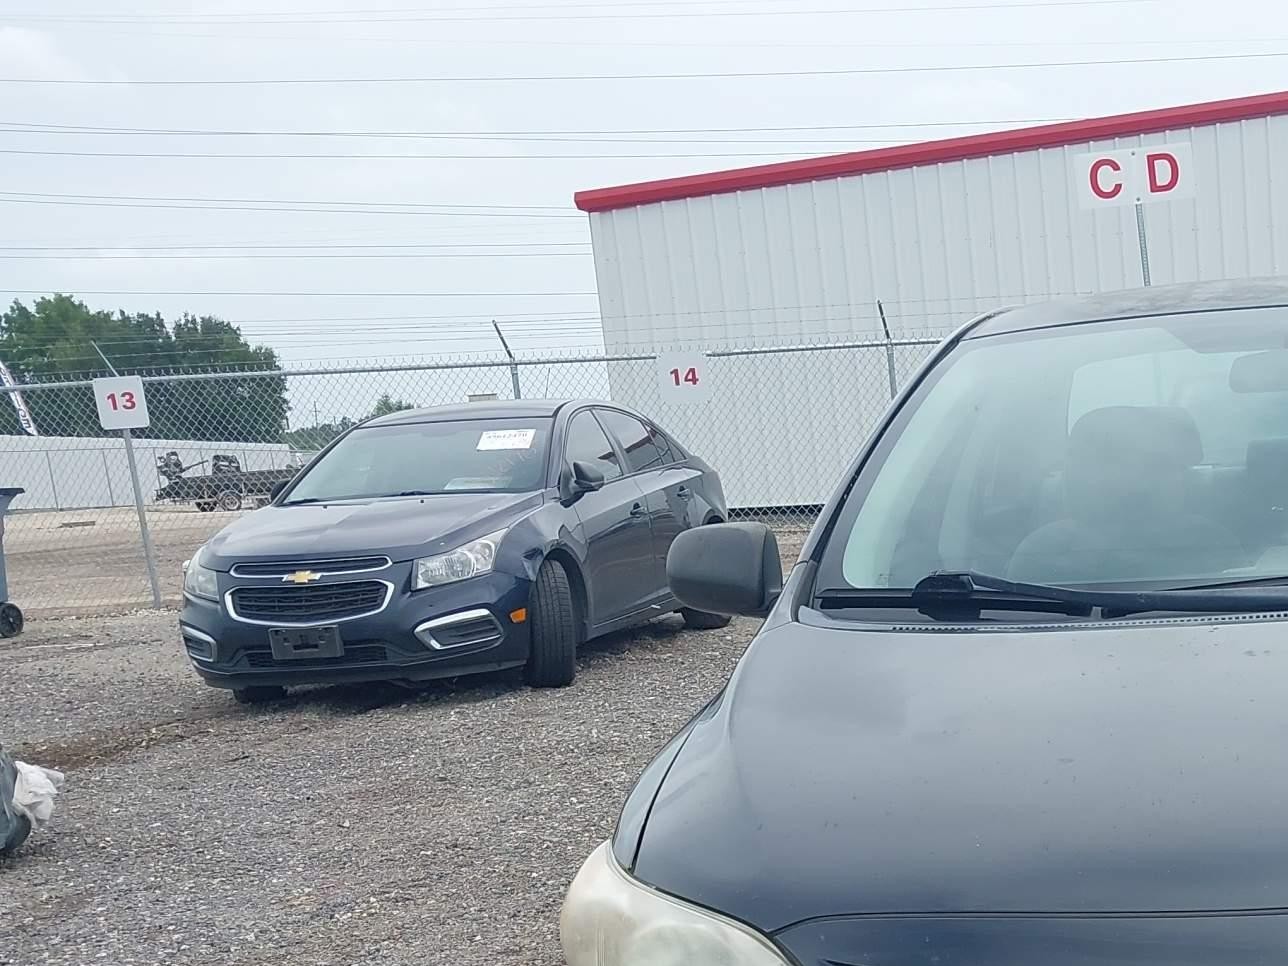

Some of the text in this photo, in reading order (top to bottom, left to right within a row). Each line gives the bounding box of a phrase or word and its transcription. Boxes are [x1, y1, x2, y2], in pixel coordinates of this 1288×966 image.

[1089, 152, 1180, 199] C D
[669, 367, 700, 386] 14
[106, 391, 136, 411] 13
